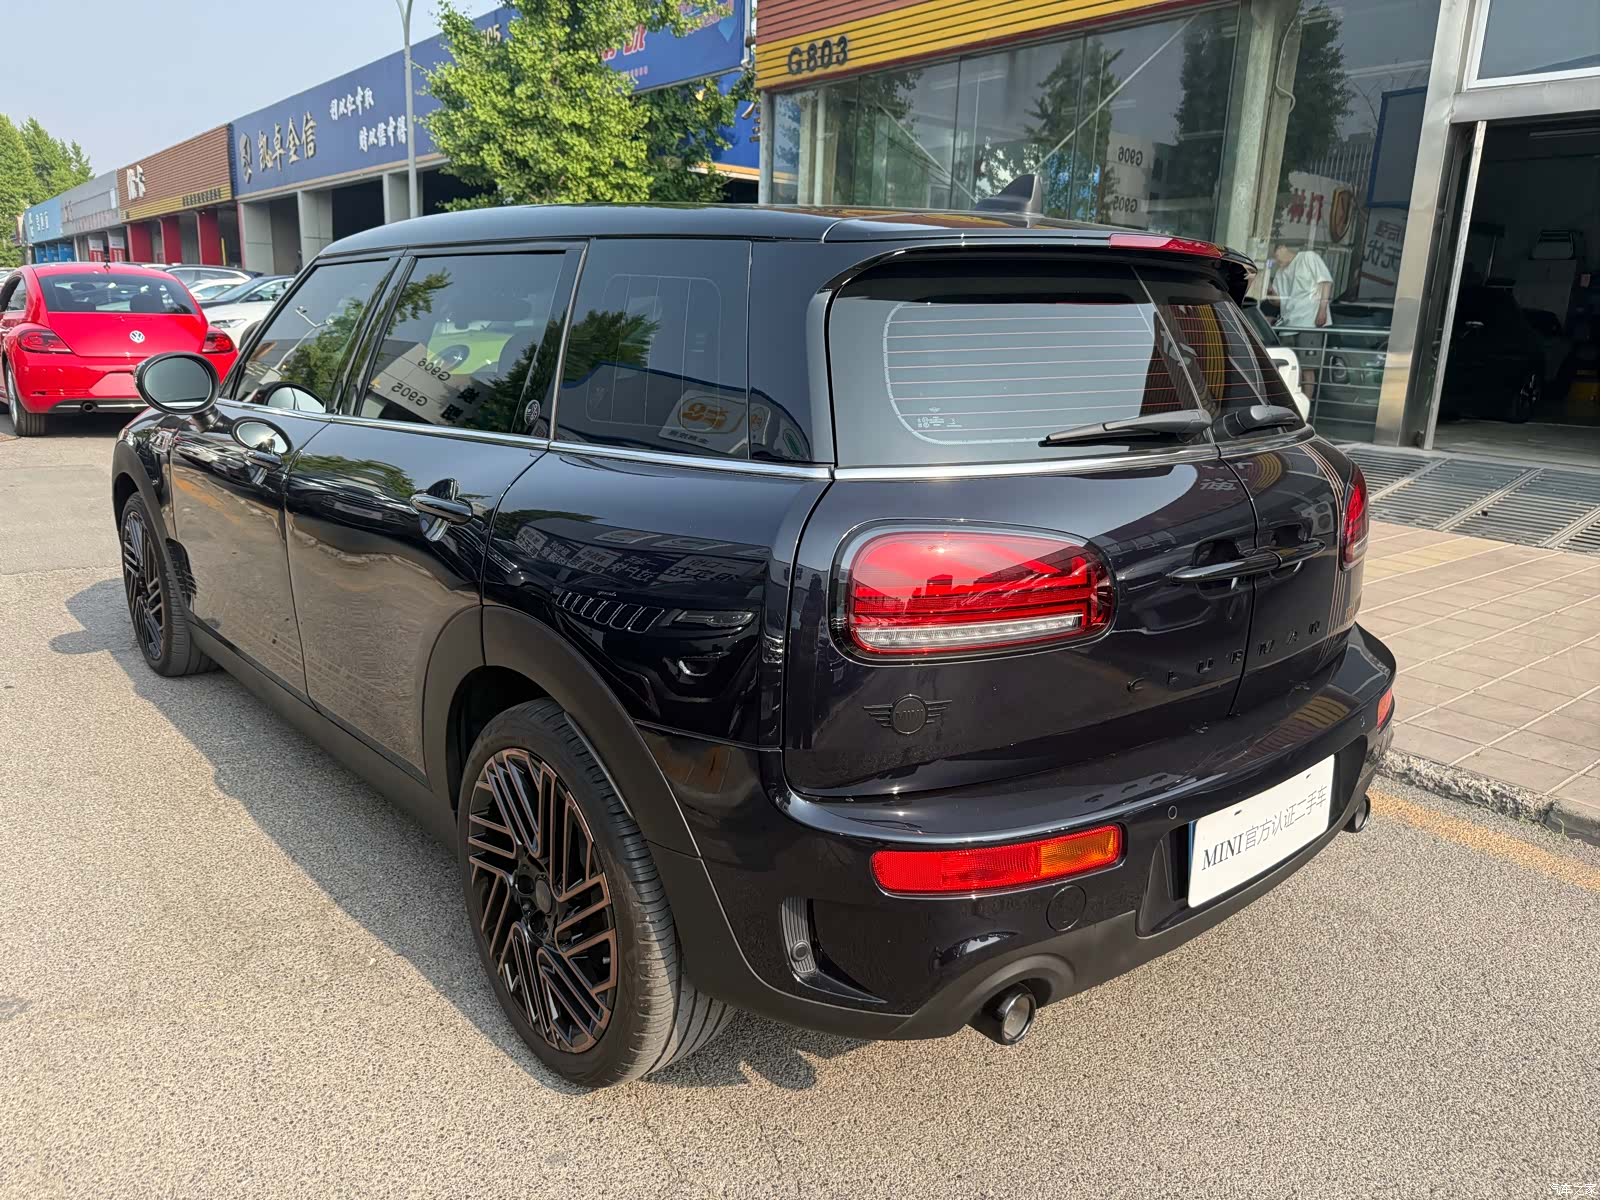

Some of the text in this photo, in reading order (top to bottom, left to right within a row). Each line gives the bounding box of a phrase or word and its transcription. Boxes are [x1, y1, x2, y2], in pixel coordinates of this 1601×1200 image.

[787, 35, 849, 75] G803
[257, 110, 318, 173] 凯卓金信
[1126, 619, 1321, 693] CLUBMAN
